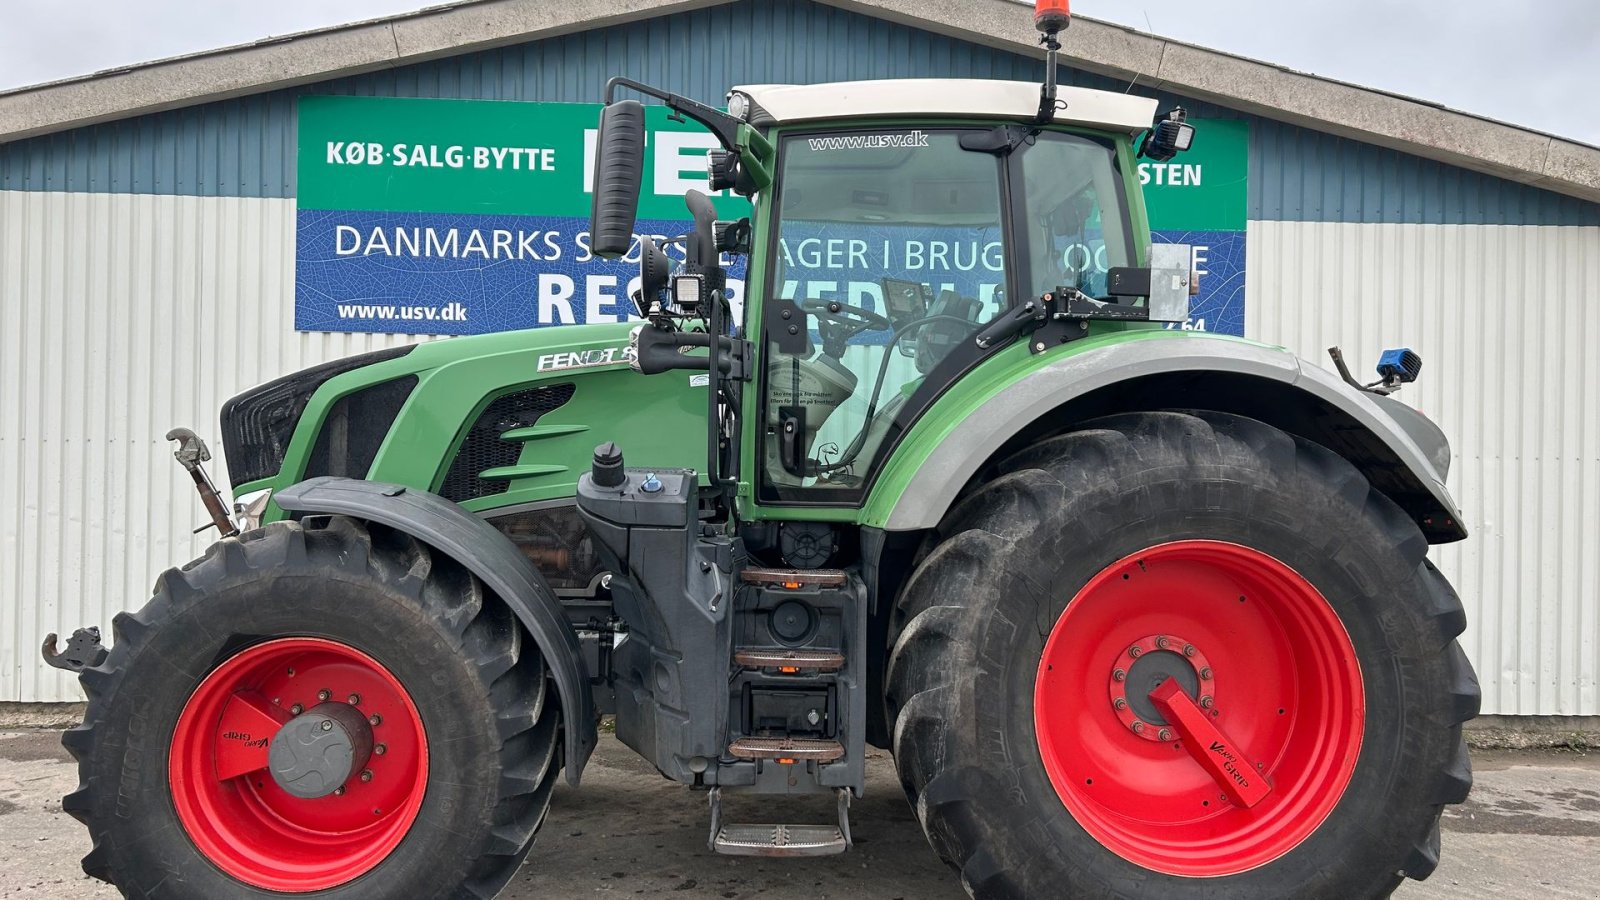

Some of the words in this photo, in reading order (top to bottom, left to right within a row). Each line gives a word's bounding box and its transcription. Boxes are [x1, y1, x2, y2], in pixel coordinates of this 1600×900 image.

[808, 130, 929, 151] www.usv.dk
[1138, 163, 1202, 186] STEN
[335, 225, 561, 261] DANMARKS
[779, 238, 869, 269] AGER
[905, 240, 1004, 271] BRUG
[338, 303, 467, 321] www.usv.dk
[537, 347, 618, 371] FENDT
[1223, 761, 1249, 788] GRIP
